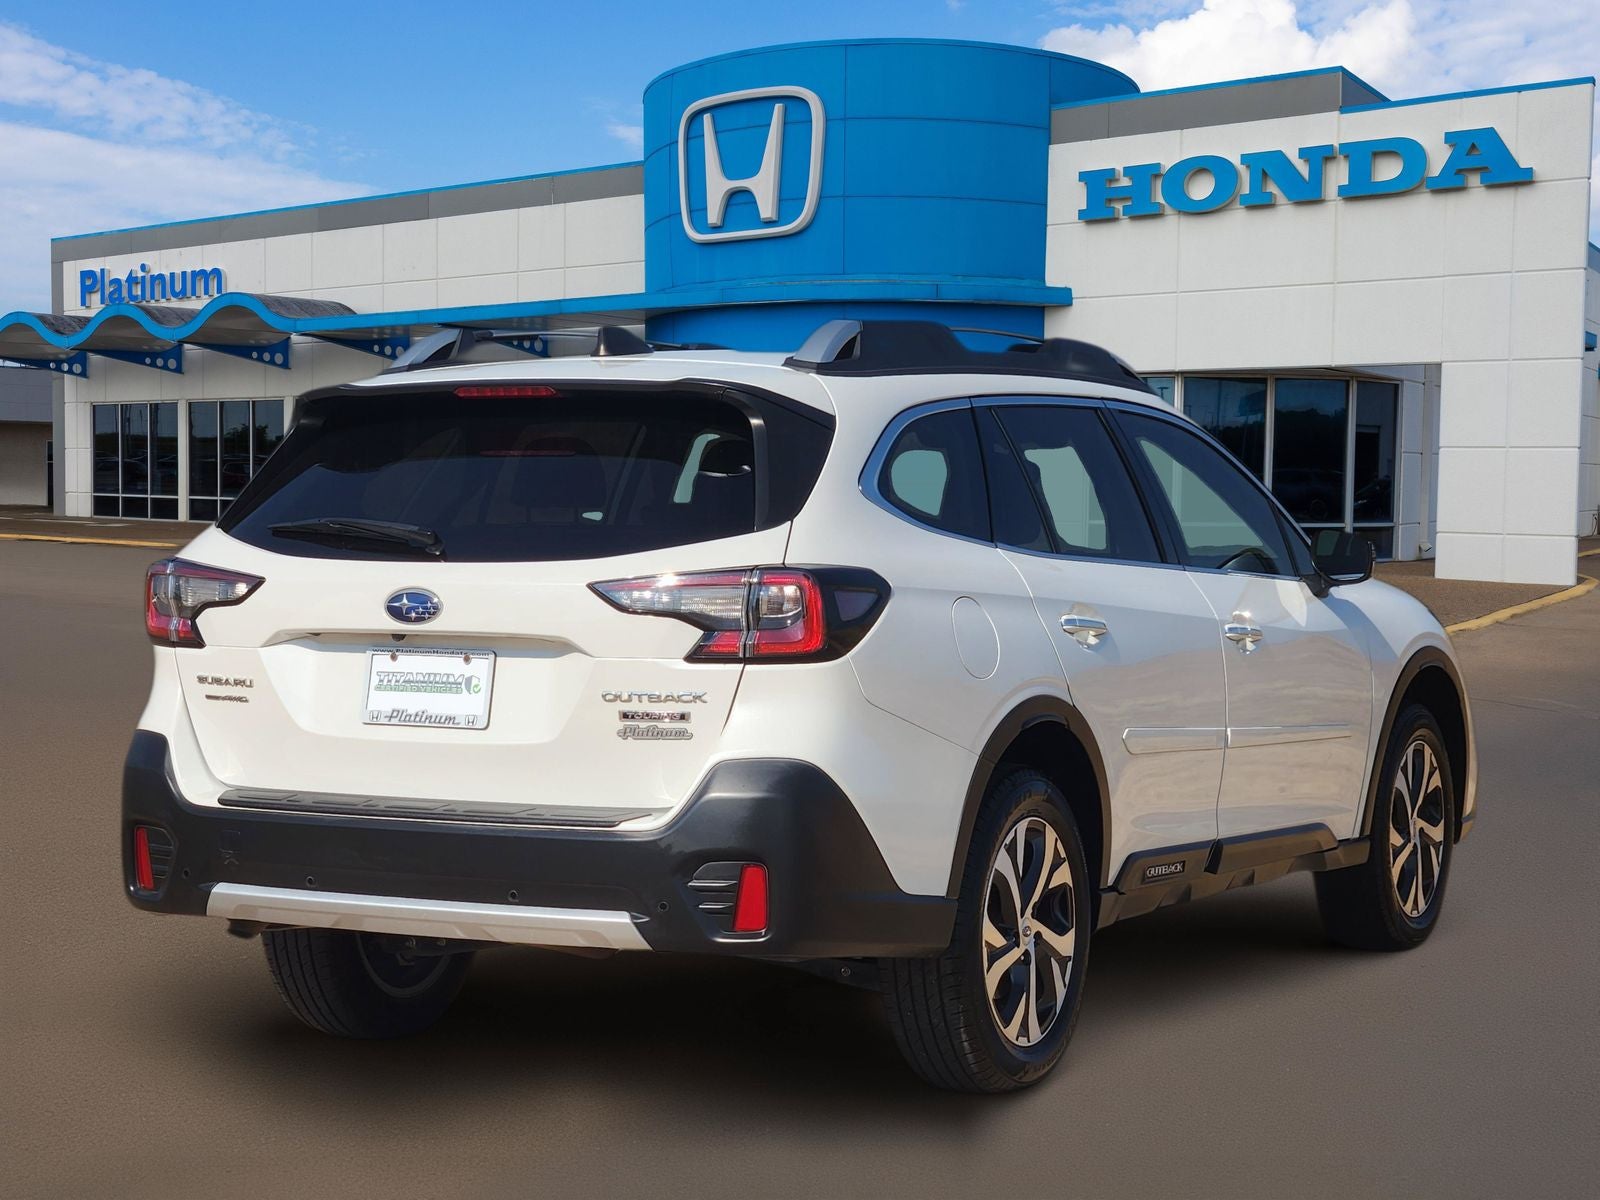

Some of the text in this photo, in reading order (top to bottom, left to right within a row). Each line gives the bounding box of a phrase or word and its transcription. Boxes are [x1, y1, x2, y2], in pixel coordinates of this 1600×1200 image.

[1078, 127, 1534, 222] HONDA
[79, 263, 227, 308] Platinum
[197, 675, 254, 688] SUBARU
[376, 671, 465, 686] TITANIUM
[601, 691, 708, 704] OUTBACK
[384, 708, 461, 725] Platinum
[625, 712, 681, 720] TOURING
[616, 724, 693, 740] Platinum
[1146, 862, 1184, 877] OUTBACK
